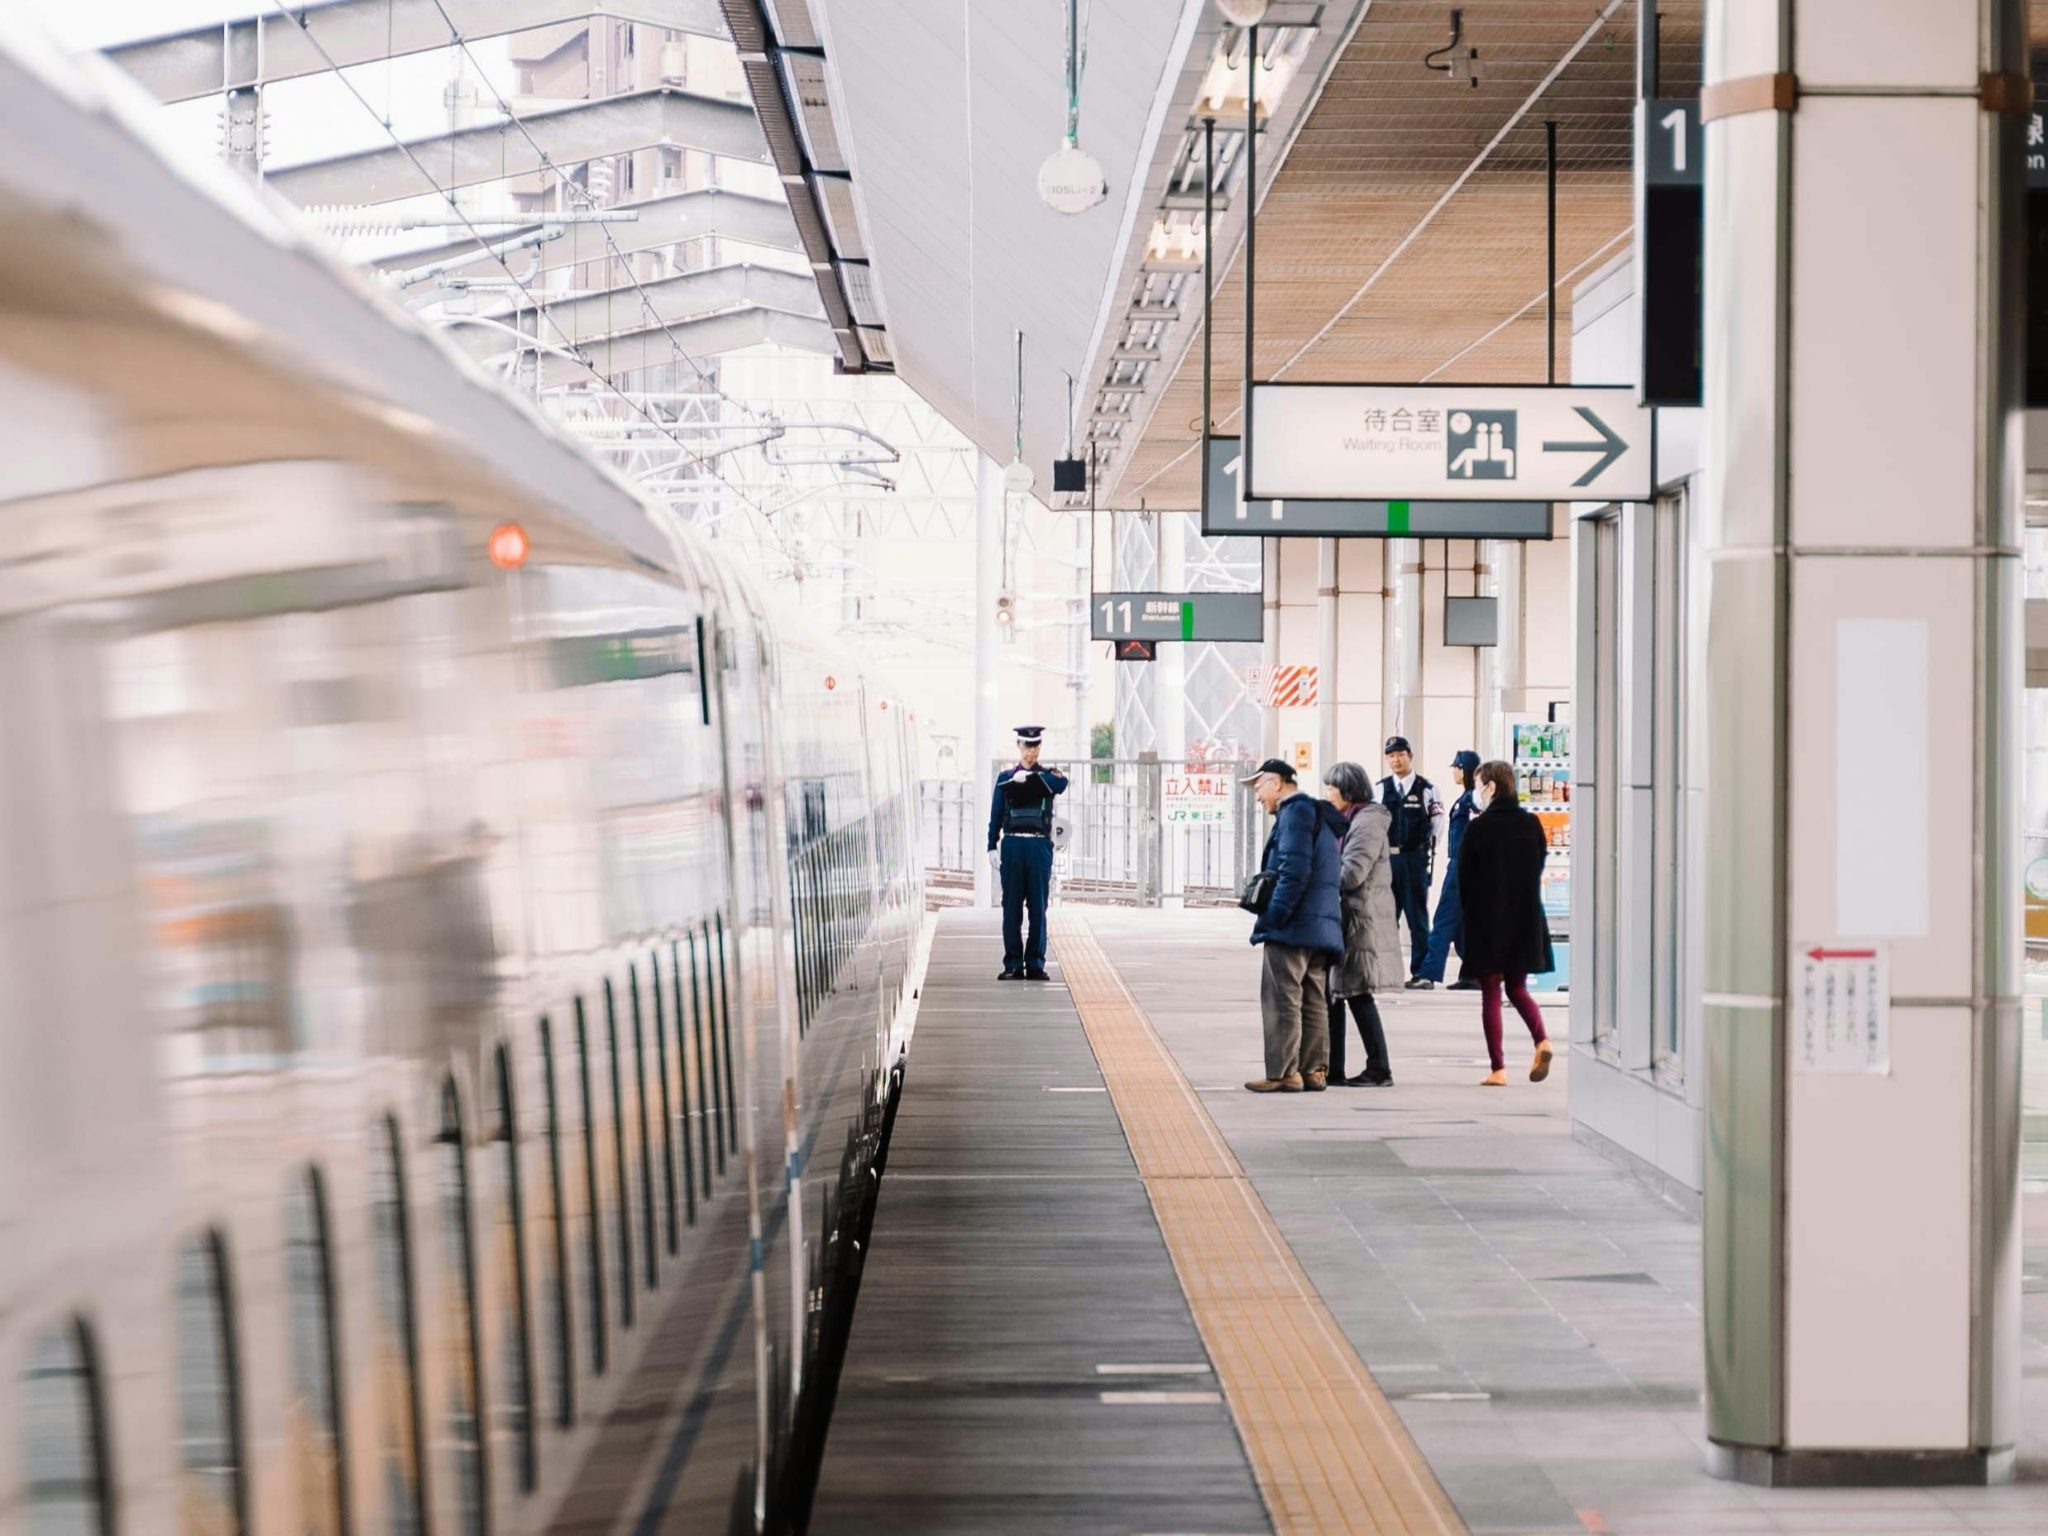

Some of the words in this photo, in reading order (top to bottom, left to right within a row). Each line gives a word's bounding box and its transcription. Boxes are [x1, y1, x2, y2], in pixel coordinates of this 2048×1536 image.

[1363, 406, 1441, 432] 待合室
[1343, 437, 1395, 453] Waiting
[1399, 437, 1442, 451] Room
[1100, 600, 1132, 633] 11
[1165, 777, 1229, 796] 立入禁止
